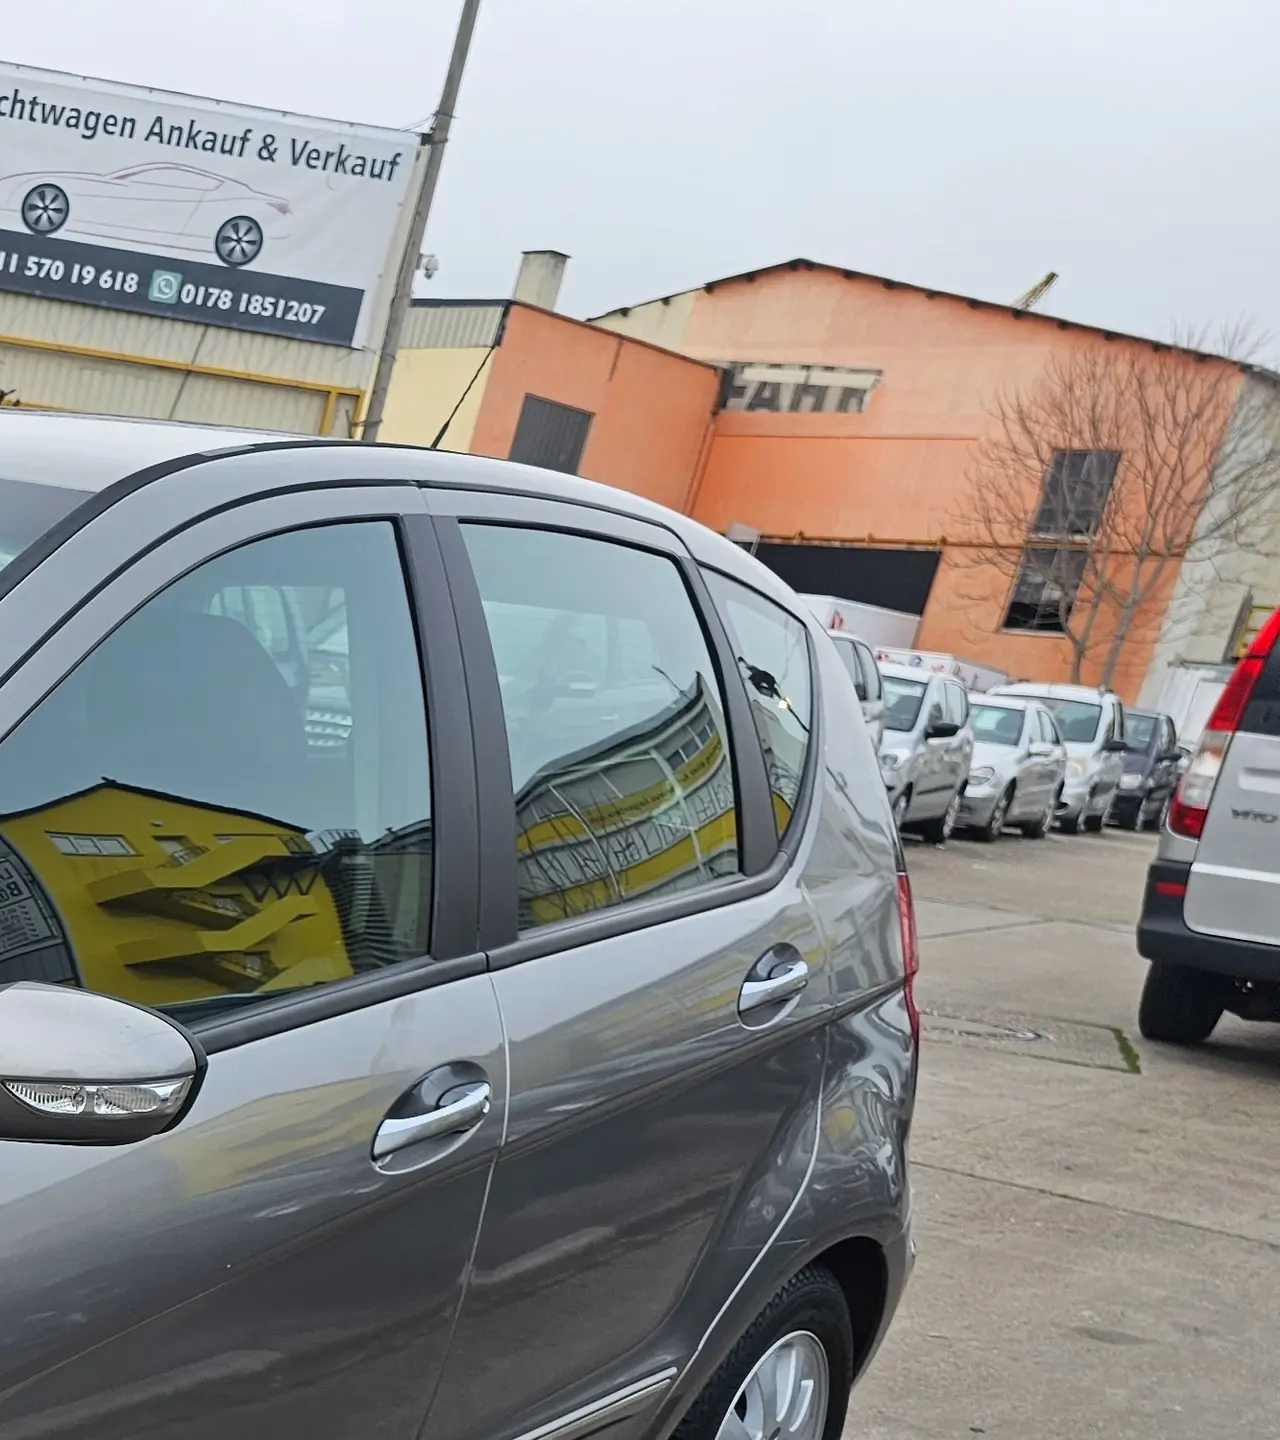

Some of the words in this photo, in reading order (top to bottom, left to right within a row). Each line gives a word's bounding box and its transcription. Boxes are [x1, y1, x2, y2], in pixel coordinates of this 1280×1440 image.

[145, 115, 253, 159] Ankauf
[257, 134, 278, 163] &
[289, 137, 404, 182] Verkauf
[24, 257, 65, 282] 570
[71, 263, 95, 286] 19
[99, 269, 139, 293] 618
[180, 283, 233, 311] 0178
[238, 291, 326, 325] 1851207
